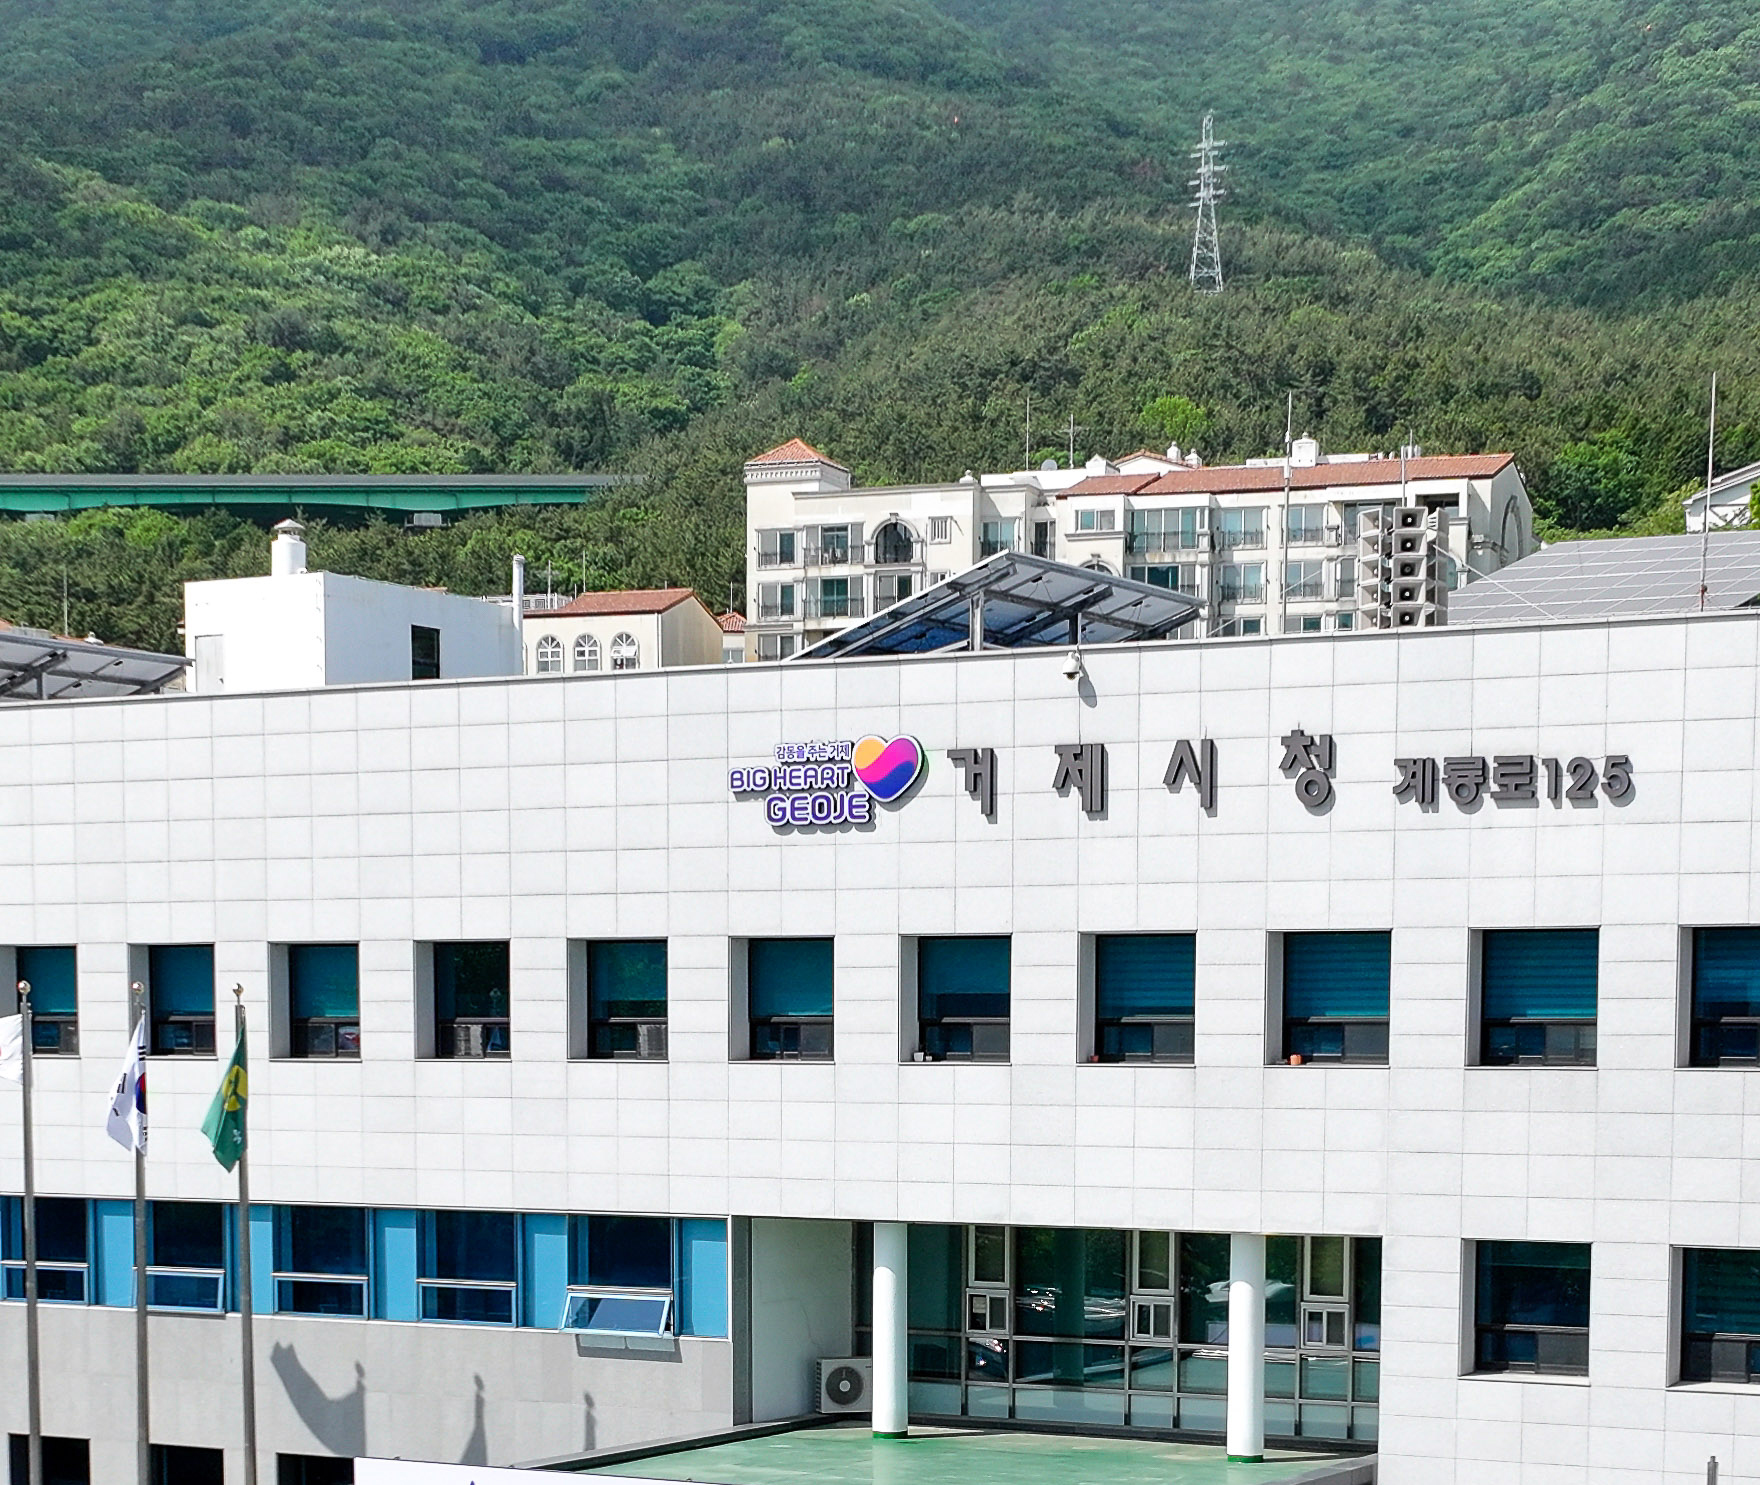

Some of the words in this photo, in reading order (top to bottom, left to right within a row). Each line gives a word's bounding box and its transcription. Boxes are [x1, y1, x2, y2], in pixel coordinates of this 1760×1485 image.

[776, 745, 805, 760] 감동을
[808, 744, 827, 758] 주는
[830, 743, 850, 760] 거제
[730, 768, 767, 789] BIG
[773, 765, 850, 788] HEART
[947, 729, 1333, 817] 거제시청
[1392, 754, 1634, 806] 계룡로125
[766, 793, 870, 823] GEOJE
